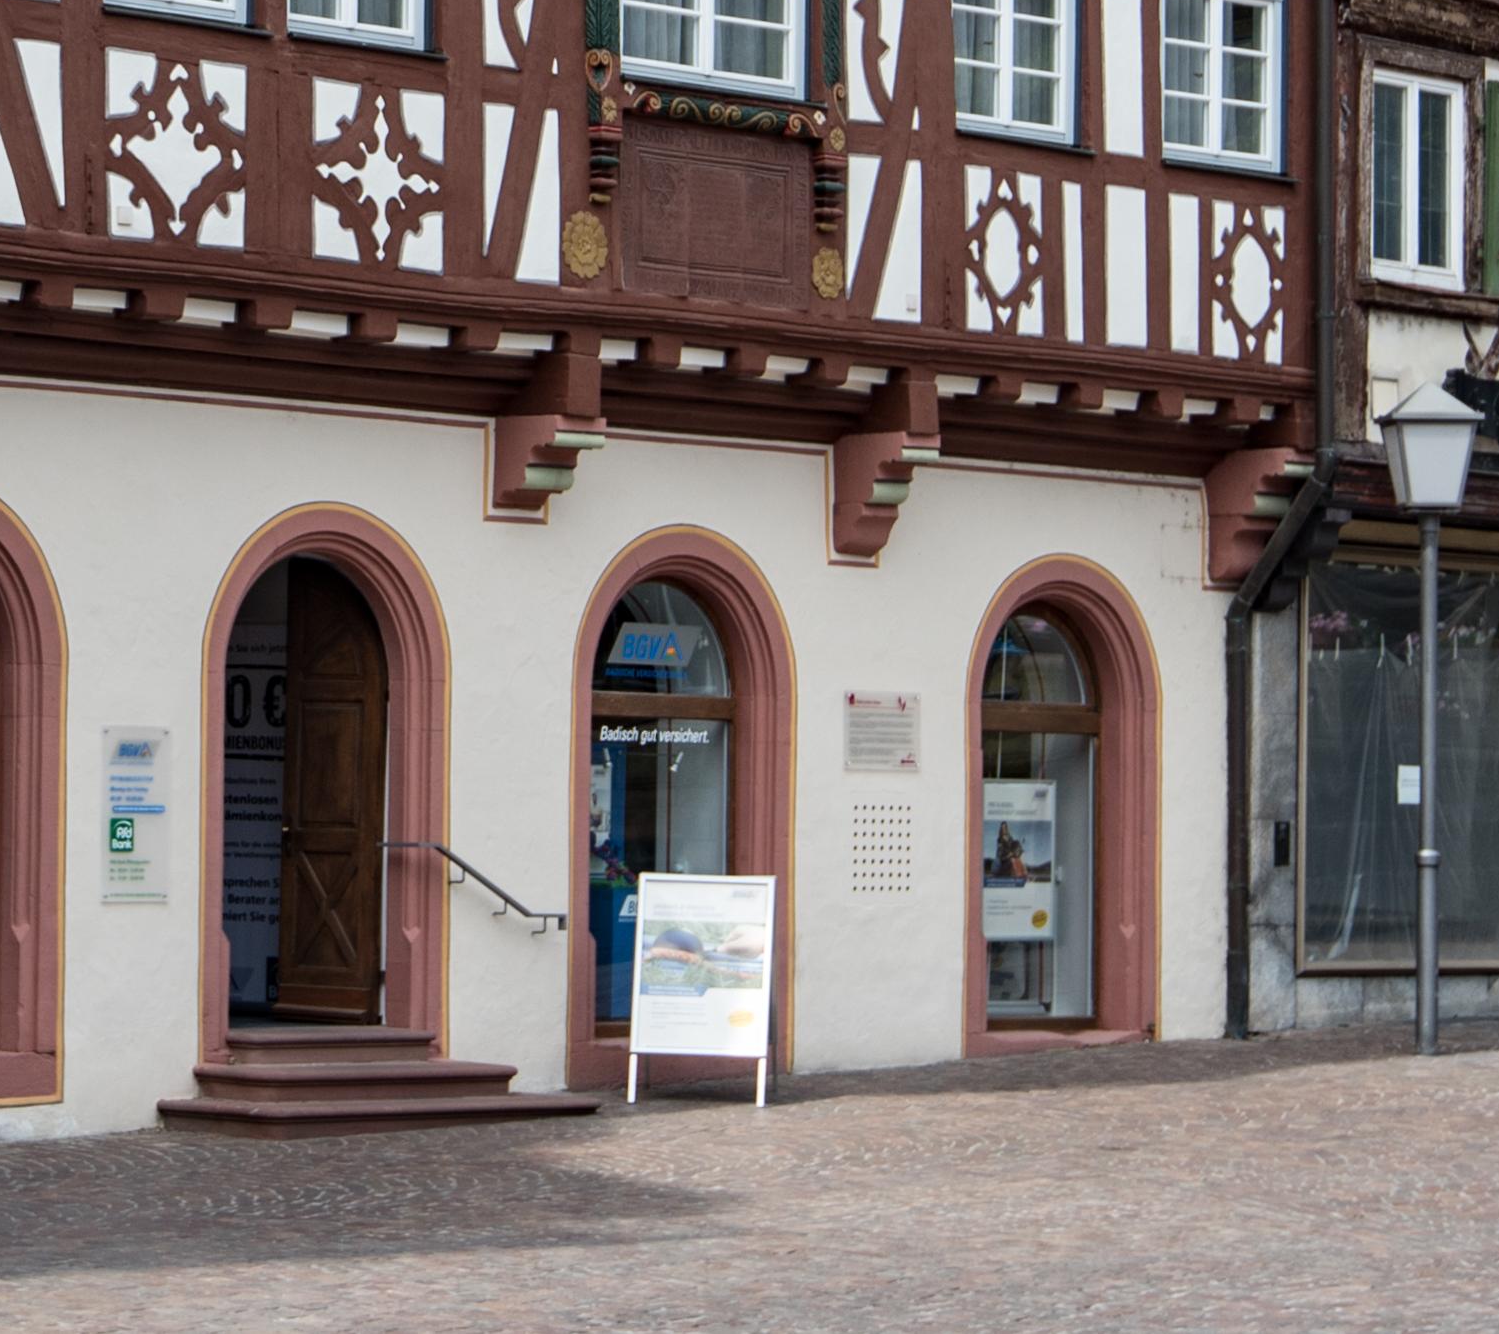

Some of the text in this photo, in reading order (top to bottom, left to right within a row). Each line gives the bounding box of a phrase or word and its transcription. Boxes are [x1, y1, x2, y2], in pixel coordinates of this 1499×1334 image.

[599, 724, 710, 746] Badisch gut versichert.
